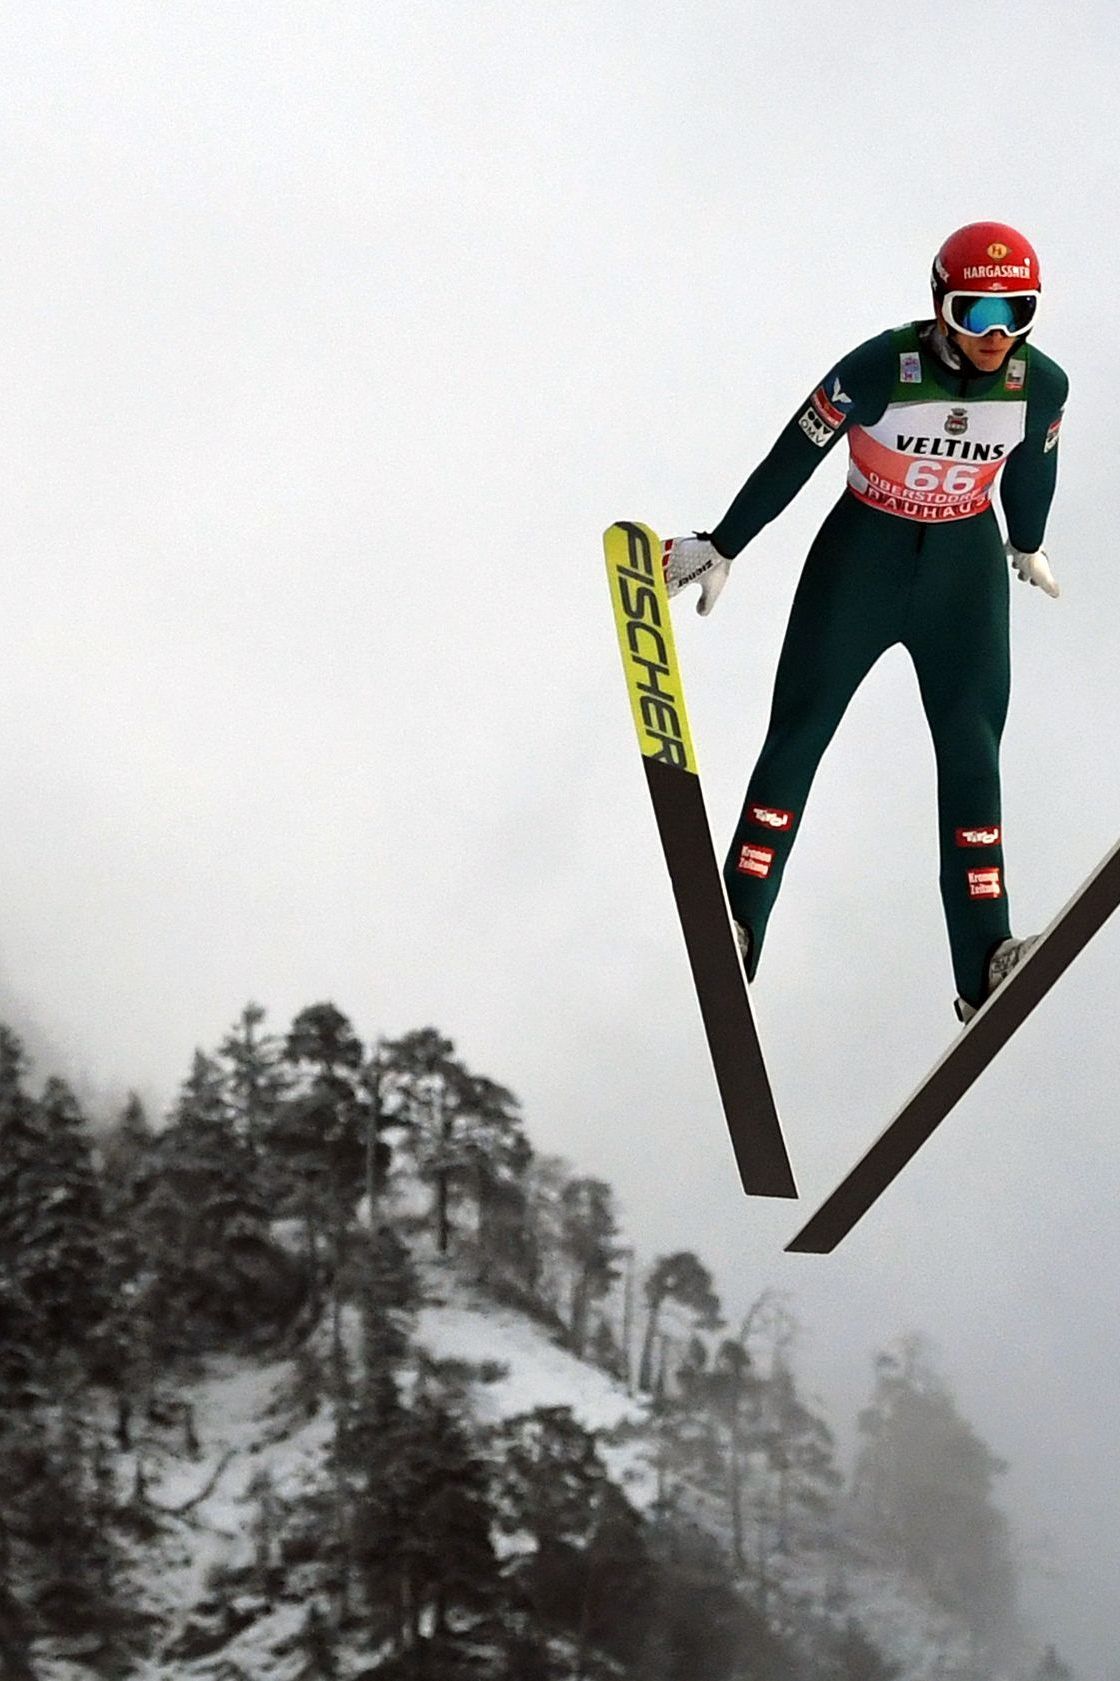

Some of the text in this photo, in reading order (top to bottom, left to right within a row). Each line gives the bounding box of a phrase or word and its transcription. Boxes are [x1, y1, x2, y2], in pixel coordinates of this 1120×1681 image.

[963, 265, 1031, 280] HARGASSNER
[800, 418, 826, 444] OMV
[896, 434, 1005, 461] VELTINS
[904, 460, 980, 495] 66
[614, 520, 688, 770] FISCHER
